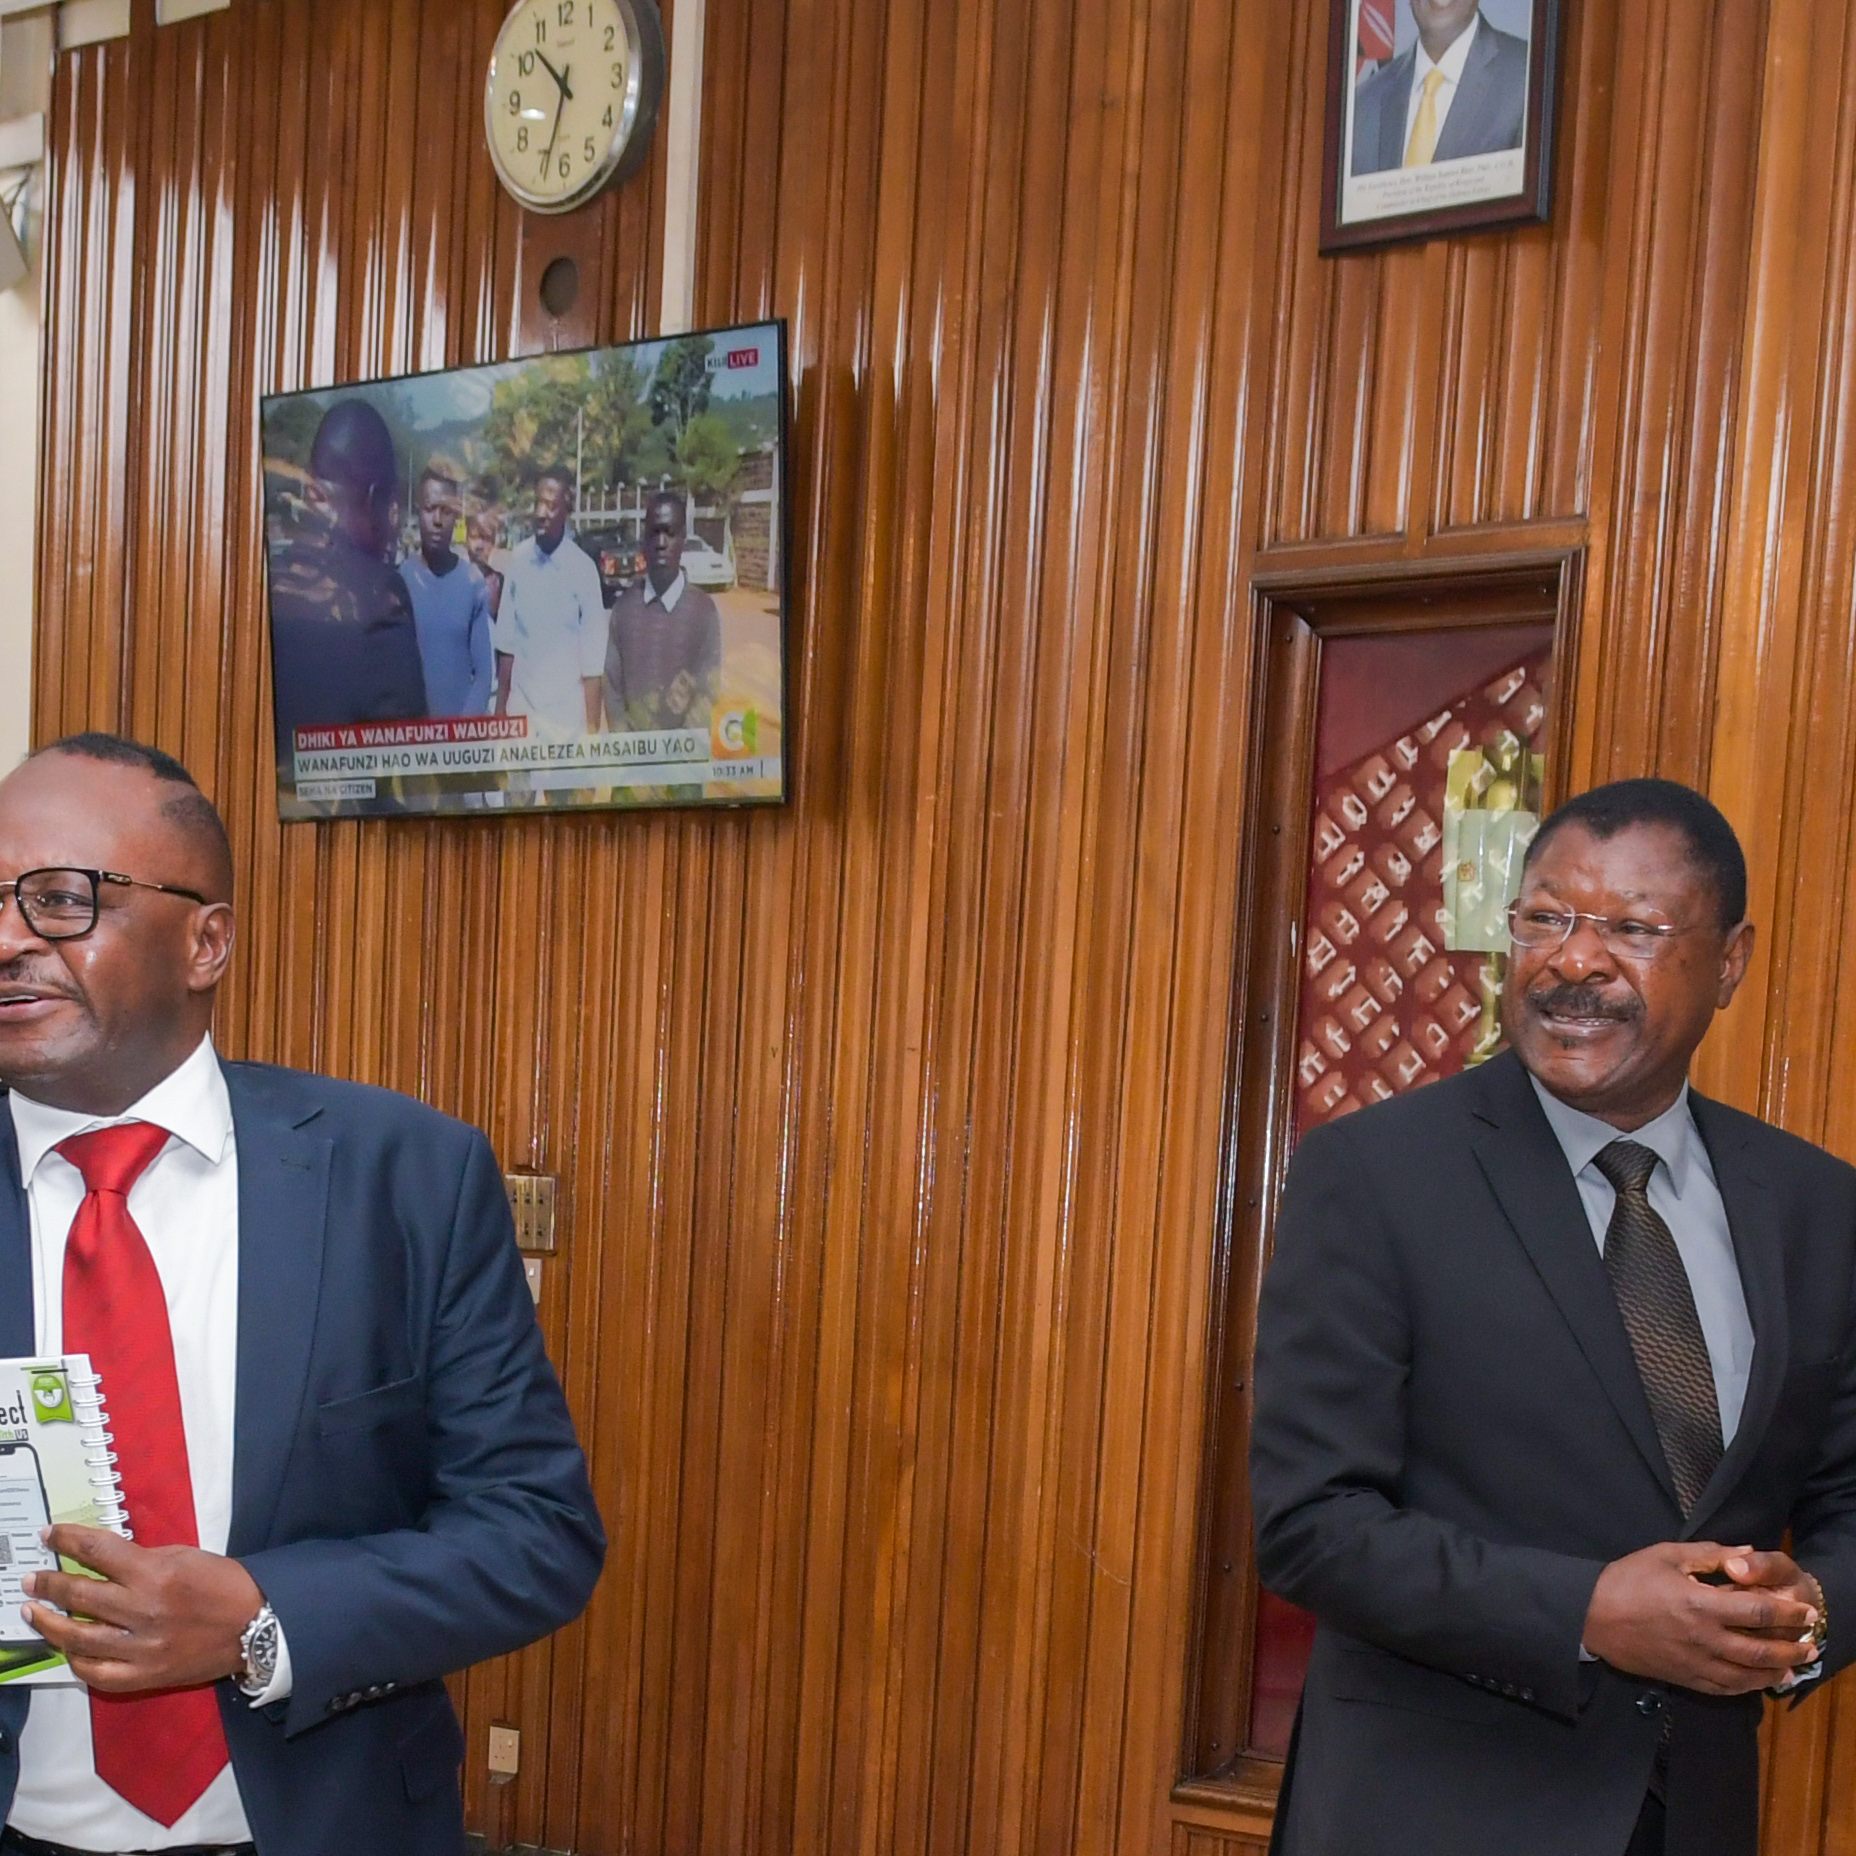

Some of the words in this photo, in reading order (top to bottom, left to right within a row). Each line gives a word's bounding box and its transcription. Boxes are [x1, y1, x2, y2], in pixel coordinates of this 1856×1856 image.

[557, 0, 574, 27] 12
[588, 2, 593, 29] 1
[536, 20, 546, 44] 11
[603, 25, 615, 52] 2
[518, 50, 535, 77] 10
[611, 62, 623, 89] 3
[509, 90, 521, 117] 9
[601, 103, 613, 129] 4
[517, 126, 529, 153] 8
[584, 136, 595, 163] 5
[538, 148, 551, 175] 7
[558, 153, 571, 179] 6
[729, 352, 756, 366] LIVE
[298, 731, 335, 750] DHIKI
[339, 730, 358, 747] YA
[360, 724, 449, 745] WANAFUNZI
[453, 720, 524, 740] WAUGUZI
[298, 756, 378, 773] WANAFUNZI
[382, 752, 412, 769] HAO
[415, 752, 438, 767] WA
[443, 748, 495, 766] UUGUZI
[500, 743, 585, 762] ANAELEZEA
[590, 738, 657, 758] MASAIBU
[662, 736, 695, 754] YAO
[740, 765, 755, 776] AM
[340, 783, 373, 795] CITIZEN
